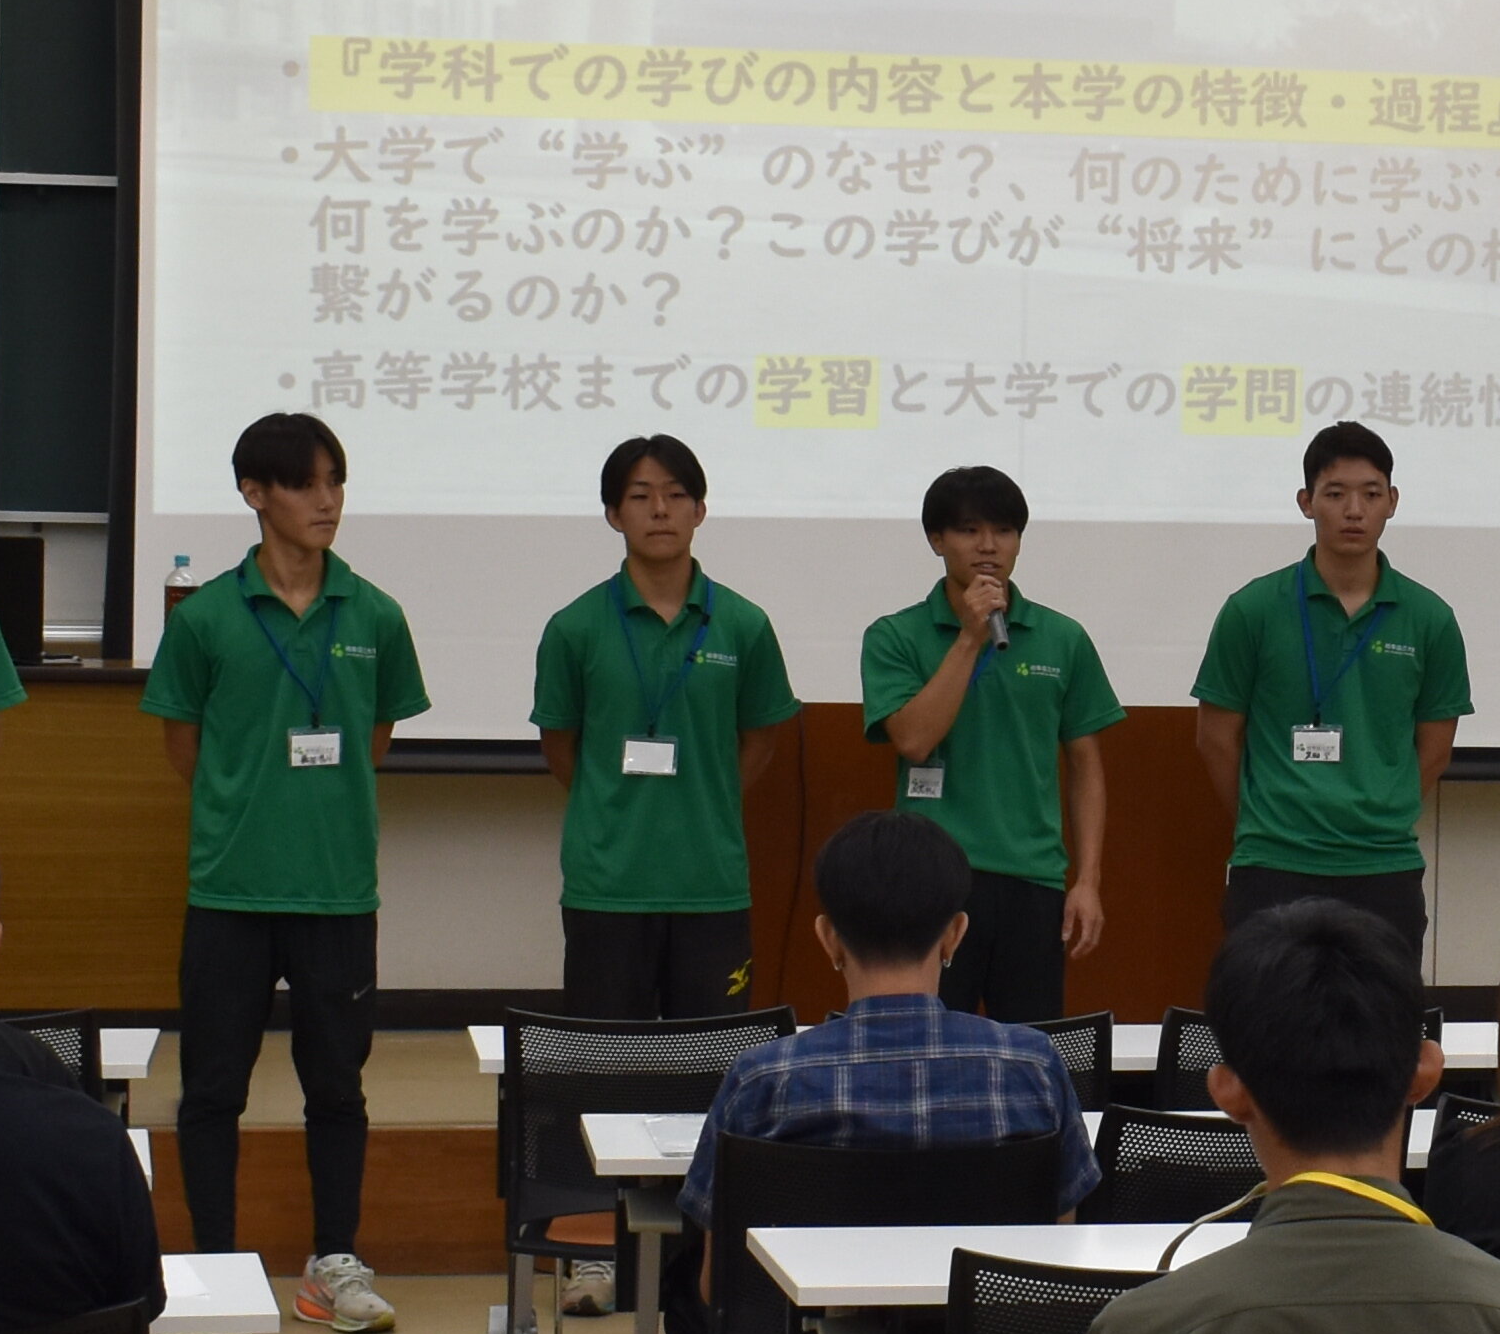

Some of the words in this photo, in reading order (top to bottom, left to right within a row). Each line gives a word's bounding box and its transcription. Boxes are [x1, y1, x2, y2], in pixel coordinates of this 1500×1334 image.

[309, 263, 683, 327] 繋がるのか？
